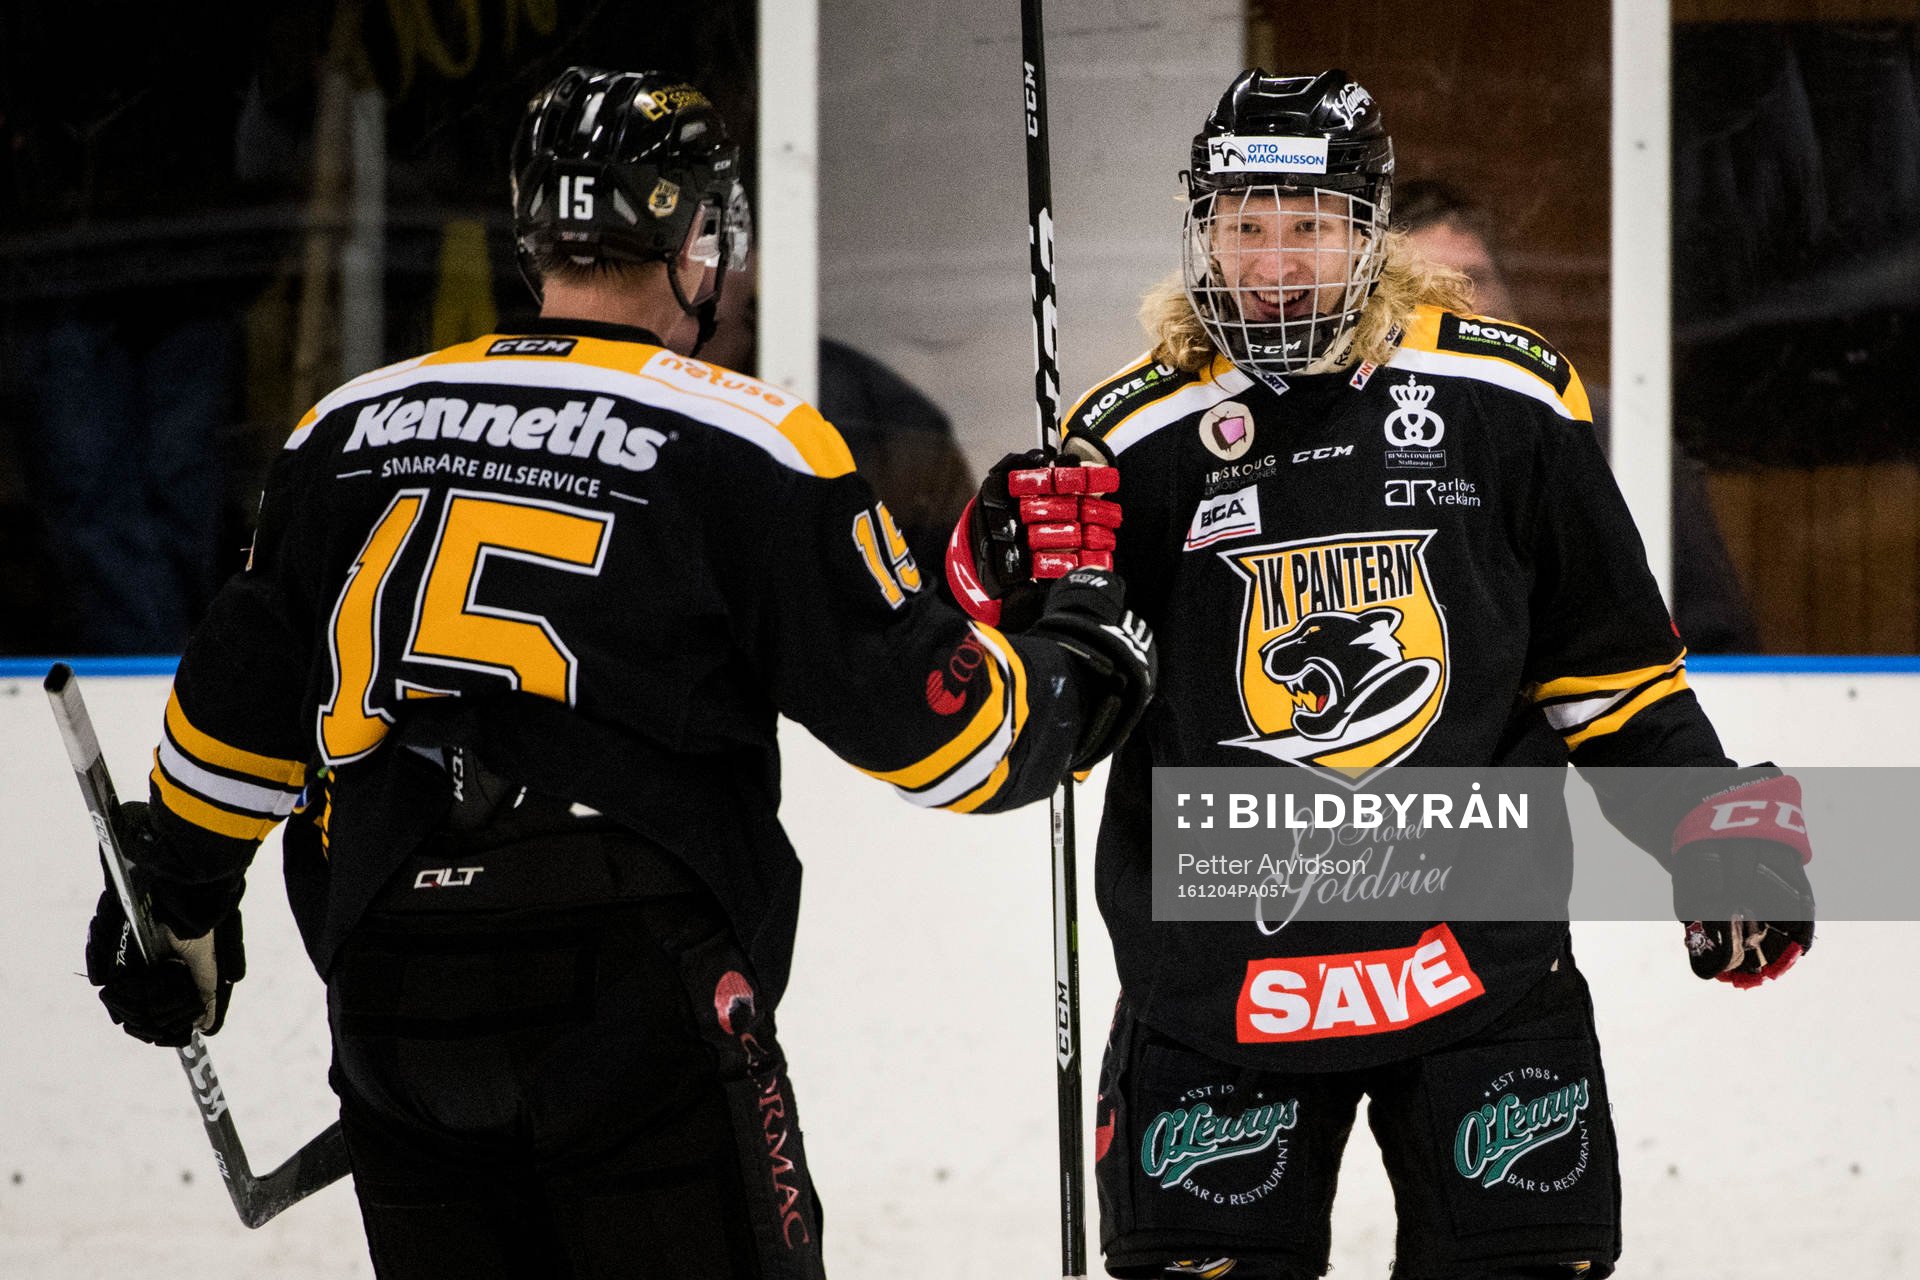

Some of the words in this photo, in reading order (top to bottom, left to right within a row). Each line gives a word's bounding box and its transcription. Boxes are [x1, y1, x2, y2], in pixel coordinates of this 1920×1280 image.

[1024, 61, 1038, 138] CCM
[1247, 143, 1278, 154] OTTO
[1247, 153, 1324, 166] MAGNUSSON
[558, 175, 595, 220] 15
[490, 340, 572, 353] CCM
[1248, 340, 1302, 354] CCM
[1458, 320, 1558, 367] MOVE4U
[1082, 363, 1175, 428] MOVE4U
[343, 397, 668, 472] Kenneths
[1292, 445, 1355, 464] CCM
[482, 462, 602, 499] BILSERVICE
[852, 500, 922, 610] 15
[1252, 556, 1290, 632] IK
[1290, 543, 1417, 622] PANTERN
[316, 488, 615, 766] 15
[1058, 980, 1070, 1056] CCM
[1187, 1085, 1213, 1099] EST
[1491, 1071, 1515, 1092] EST
[1521, 1067, 1551, 1080] 1988
[1183, 1178, 1209, 1201] BAR
[1213, 1193, 1225, 1204] &
[1230, 1136, 1289, 1206] RESTAURANT
[1507, 1173, 1535, 1191] BAR
[1540, 1182, 1550, 1193] &
[1554, 1120, 1589, 1192] RESTAURANT
